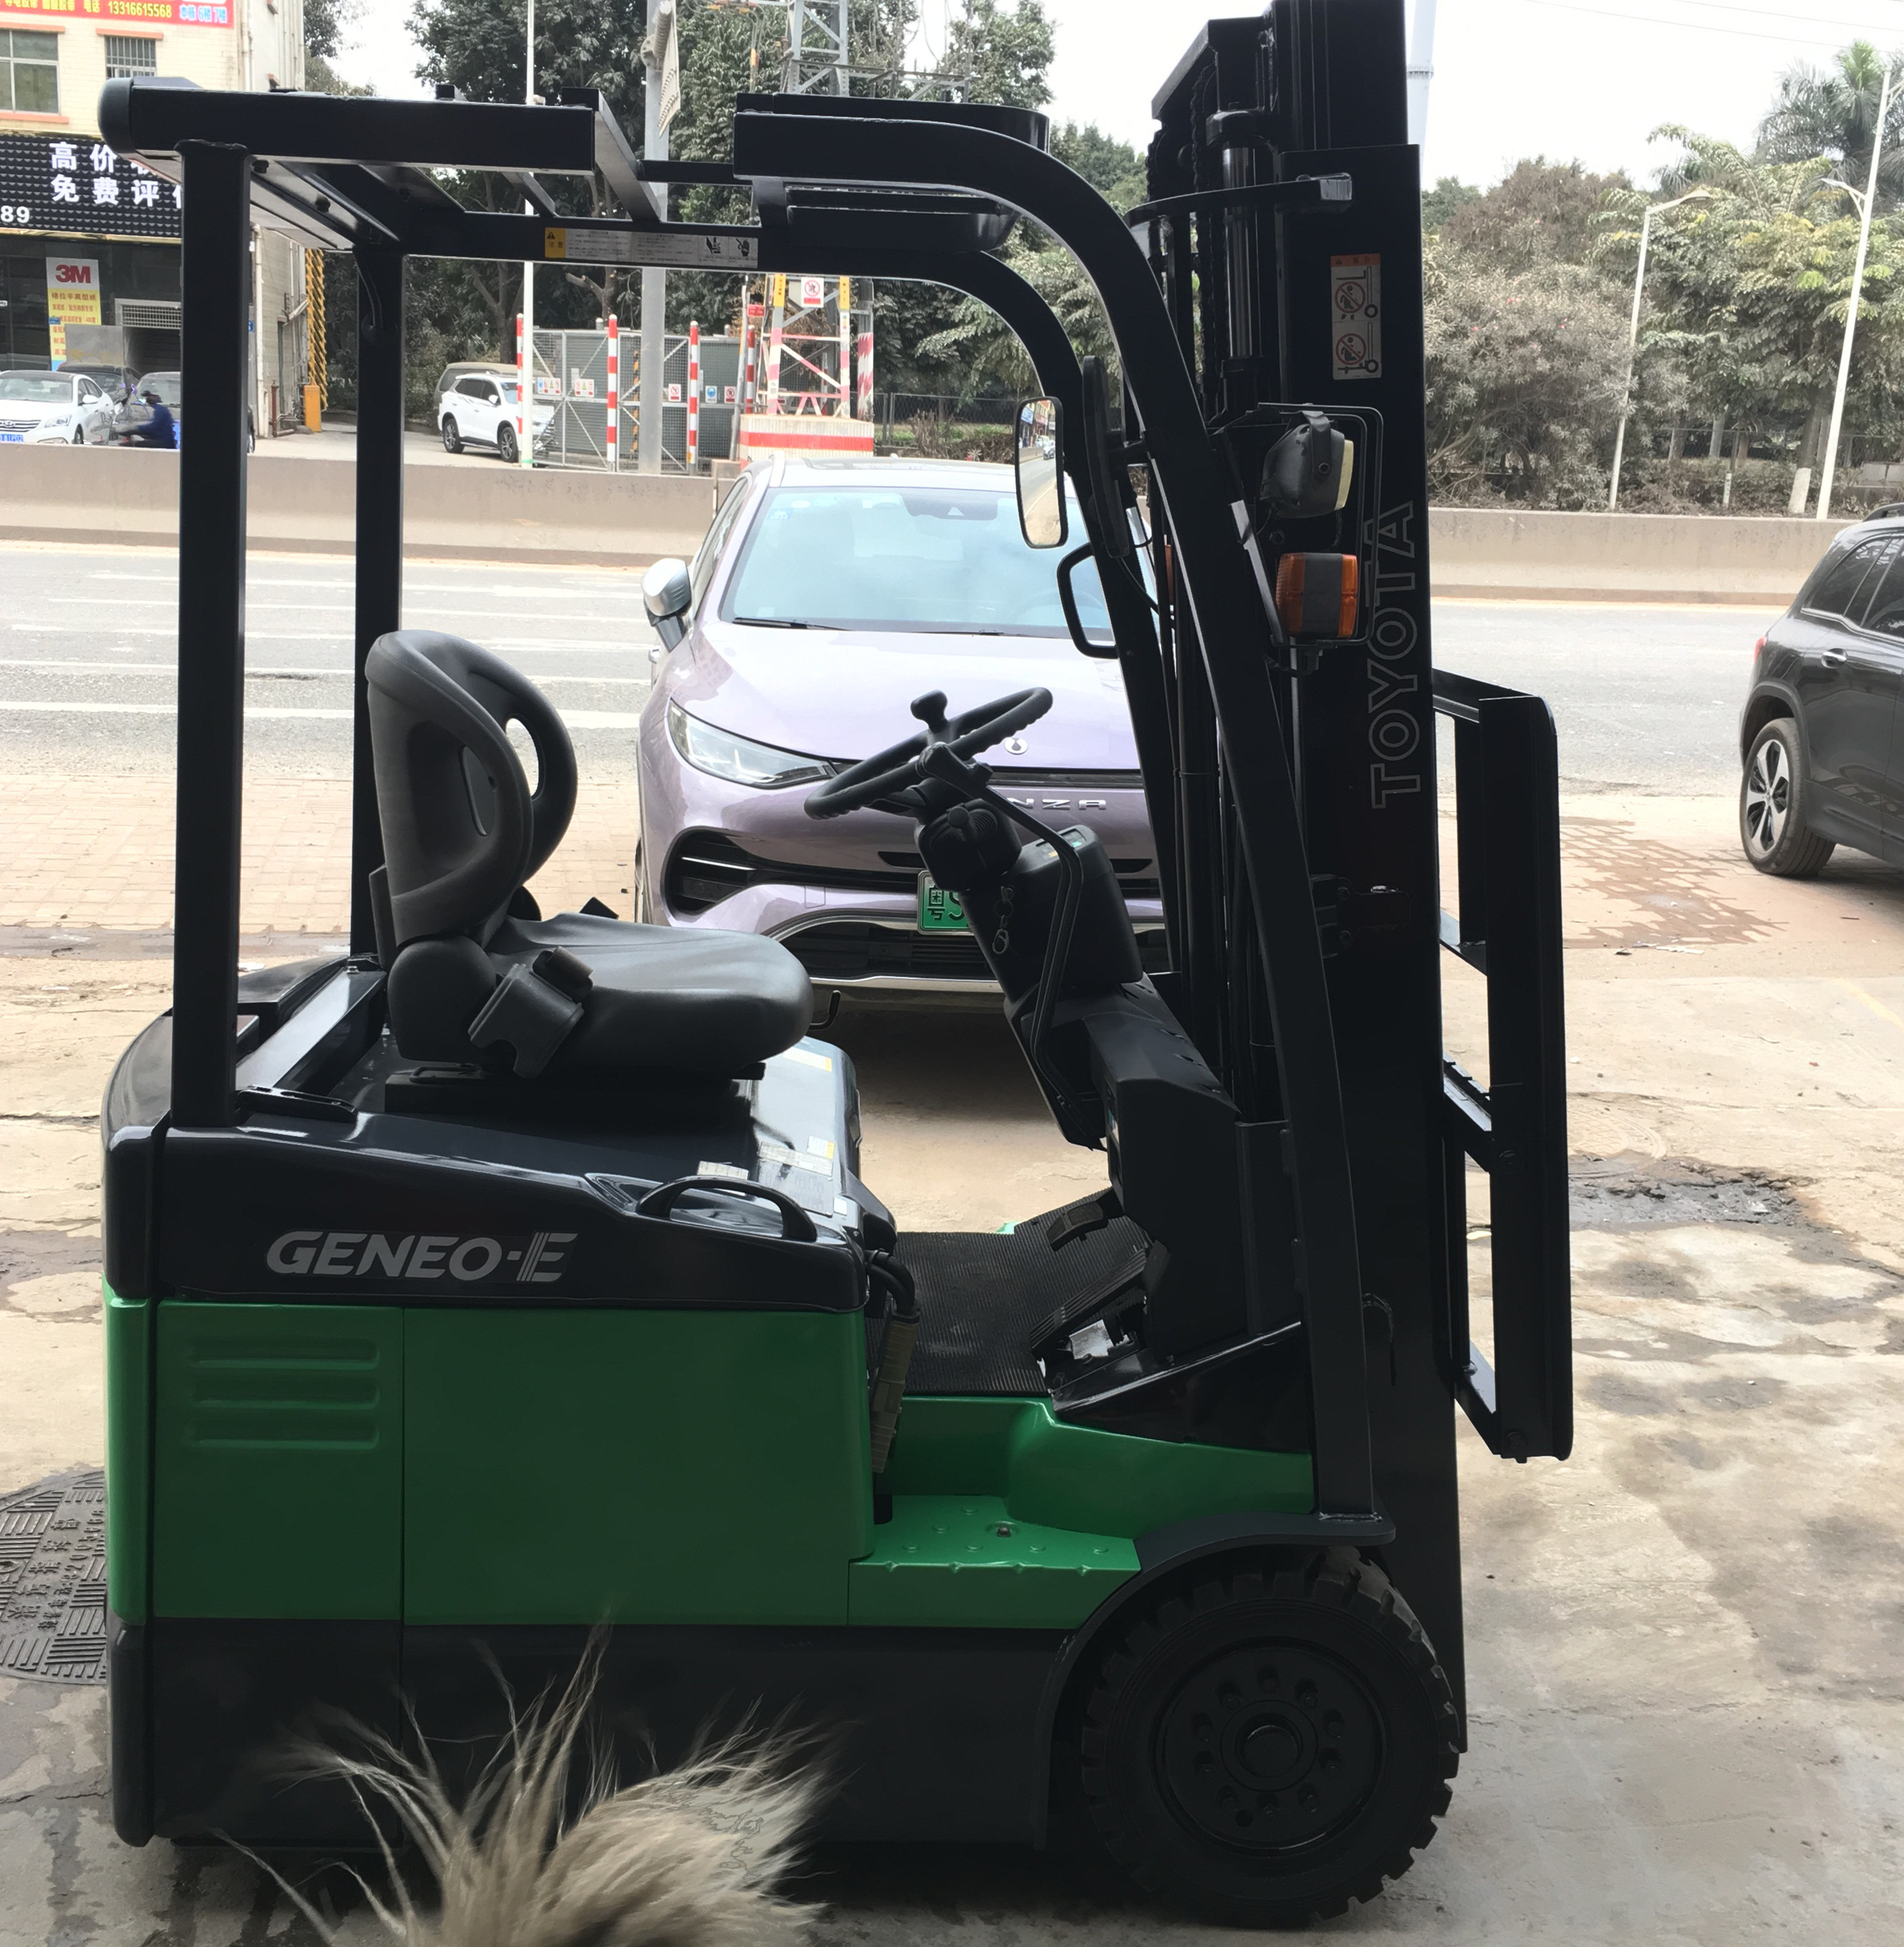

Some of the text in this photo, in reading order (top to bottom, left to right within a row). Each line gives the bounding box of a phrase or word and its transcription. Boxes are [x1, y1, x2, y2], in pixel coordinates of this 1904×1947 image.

[108, 1, 171, 18] 13316615568
[0, 205, 30, 224] 89
[56, 264, 91, 284] 3M
[1363, 500, 1421, 809] TOYOTA
[266, 1231, 579, 1282] GENEO-E
